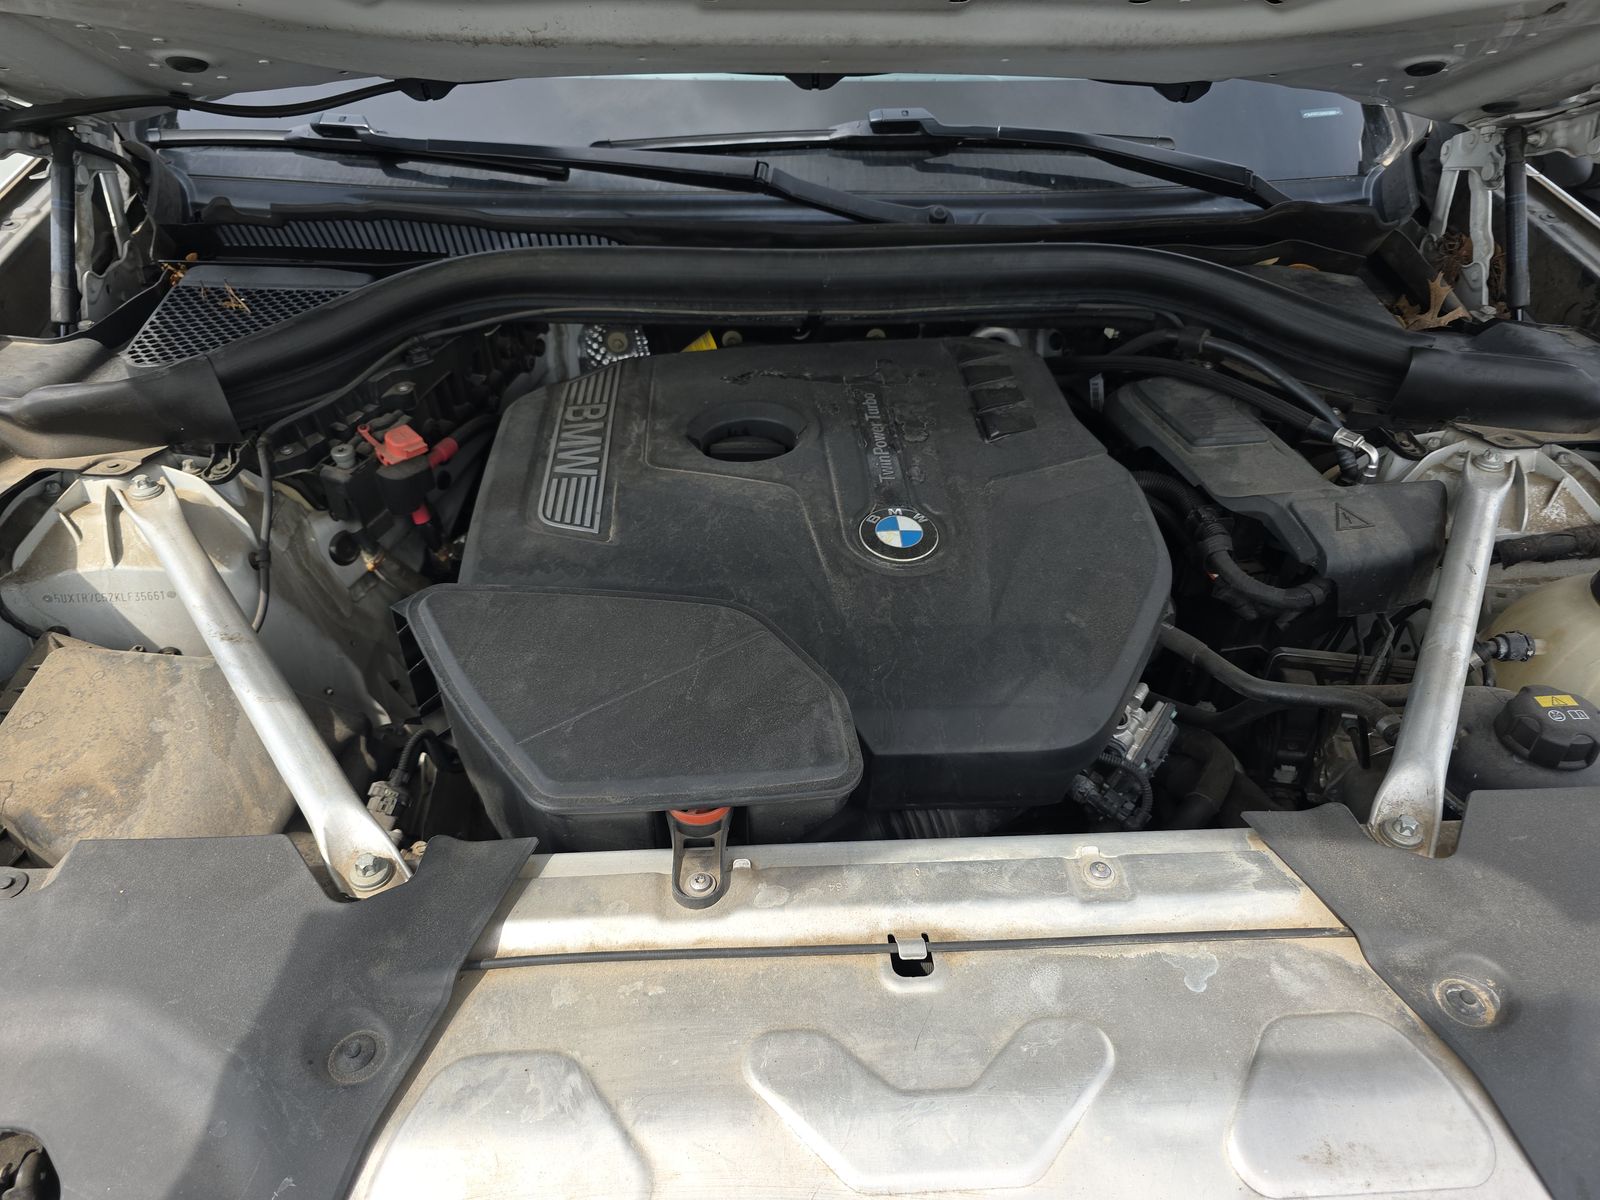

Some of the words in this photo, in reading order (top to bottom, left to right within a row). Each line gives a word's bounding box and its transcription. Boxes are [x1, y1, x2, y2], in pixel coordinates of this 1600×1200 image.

[862, 392, 882, 422] Turbo
[553, 403, 608, 476] BMW
[872, 422, 896, 484] TwinPower
[866, 507, 929, 525] BMW
